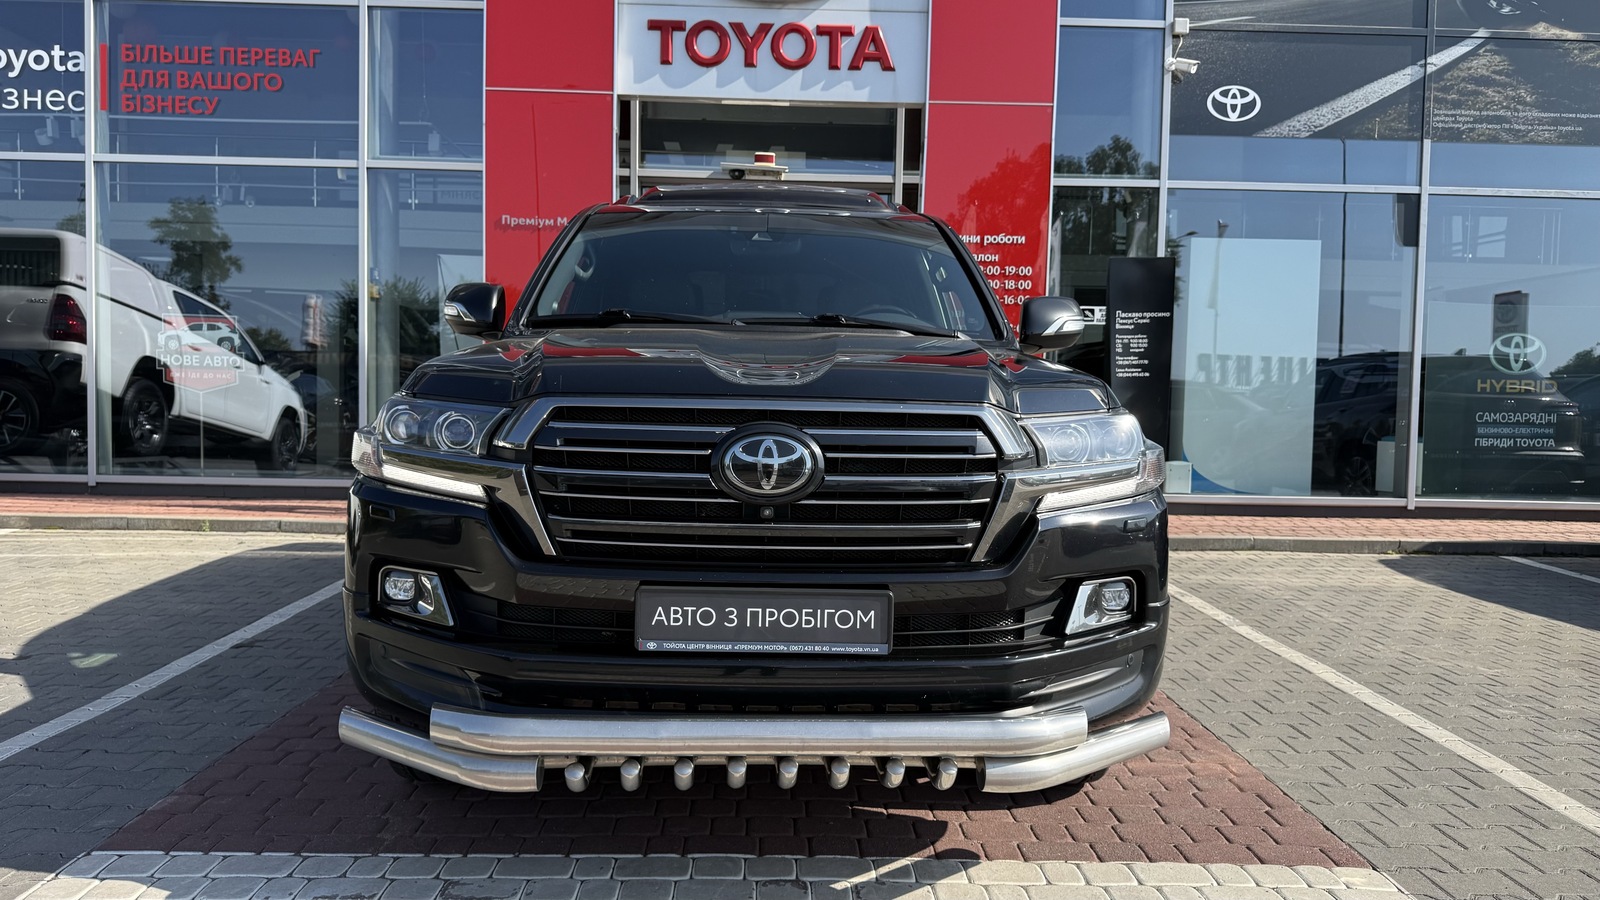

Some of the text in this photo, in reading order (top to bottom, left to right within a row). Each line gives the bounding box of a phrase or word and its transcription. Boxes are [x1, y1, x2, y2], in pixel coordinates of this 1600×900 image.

[647, 19, 896, 72] TOYOTA
[120, 44, 321, 67] БІЛЬШЕ ПЕРЕВАГ
[119, 69, 283, 91] ДЛЯ ВАШОГО
[121, 94, 219, 115] БІЗНЕСУ
[501, 214, 554, 228] Преміум
[983, 233, 1026, 246] роботи
[1143, 311, 1171, 319] просимо
[160, 353, 241, 367] НОВЕ АВТО
[1477, 379, 1558, 393] HYBRID
[1475, 412, 1557, 424] САМОЗАРЯДНІ
[1477, 426, 1554, 434] БЕНЗИНОВО-ЕЛЕКТРИЧНІ
[1474, 438, 1556, 448] ГІБРИДИ TOYOTA
[651, 606, 875, 629] АВТО З ПРОБІГОМ
